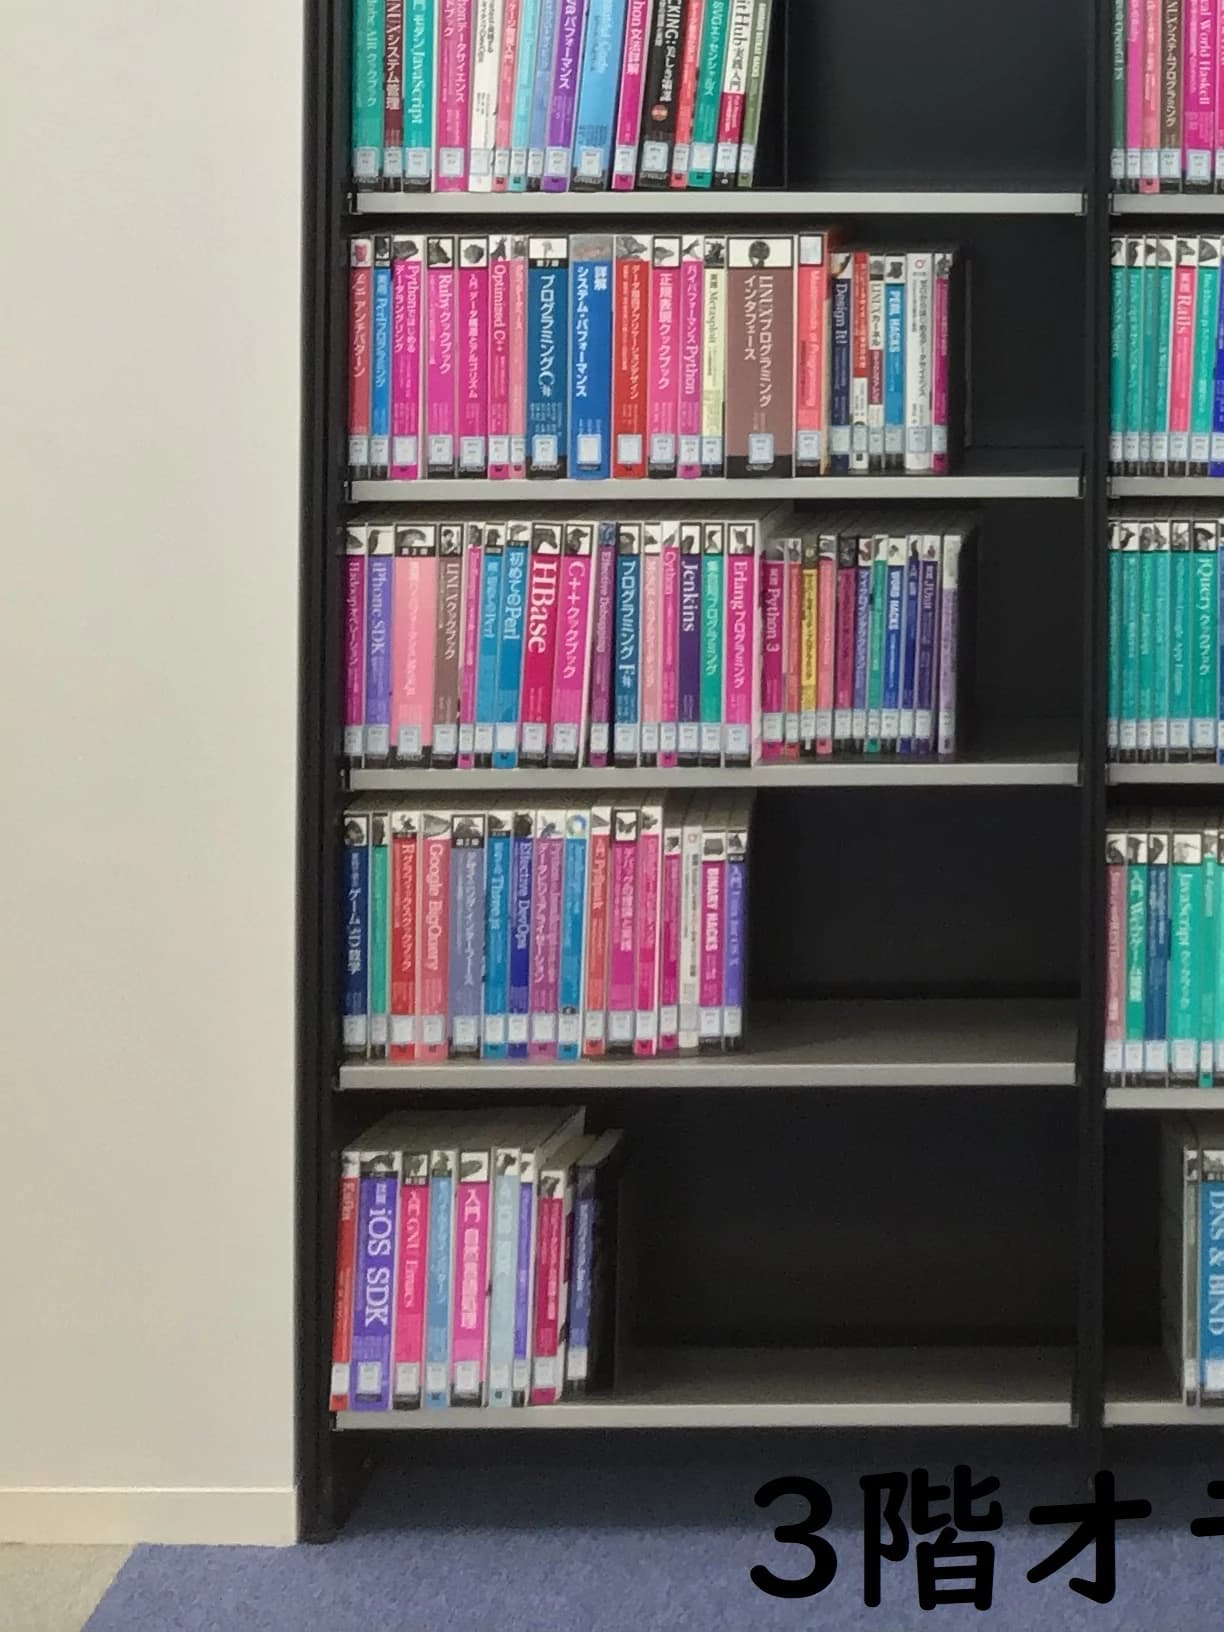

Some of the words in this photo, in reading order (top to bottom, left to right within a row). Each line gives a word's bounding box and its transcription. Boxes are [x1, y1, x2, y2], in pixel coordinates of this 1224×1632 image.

[1200, 18, 1212, 56] World
[1199, 57, 1211, 105] Haskell
[538, 274, 555, 397] プログラミングC#
[576, 266, 589, 398] システム・パフォーマンス
[657, 272, 673, 390] 正規表現クックブック
[743, 275, 758, 360] インタフェース
[832, 283, 848, 327] Design
[889, 317, 900, 353] HACKS
[1176, 294, 1192, 335] Rails
[758, 275, 774, 409] LINUXプログラミング
[527, 560, 558, 654] HBase
[563, 561, 586, 679] C++クックブック
[619, 560, 636, 659] プログラミング
[682, 561, 700, 632] Jenkins
[767, 586, 781, 642] Python
[426, 843, 444, 897] Google
[427, 899, 443, 971] BigQuery
[367, 1208, 392, 1256] iOS
[365, 1267, 391, 1327] SDK
